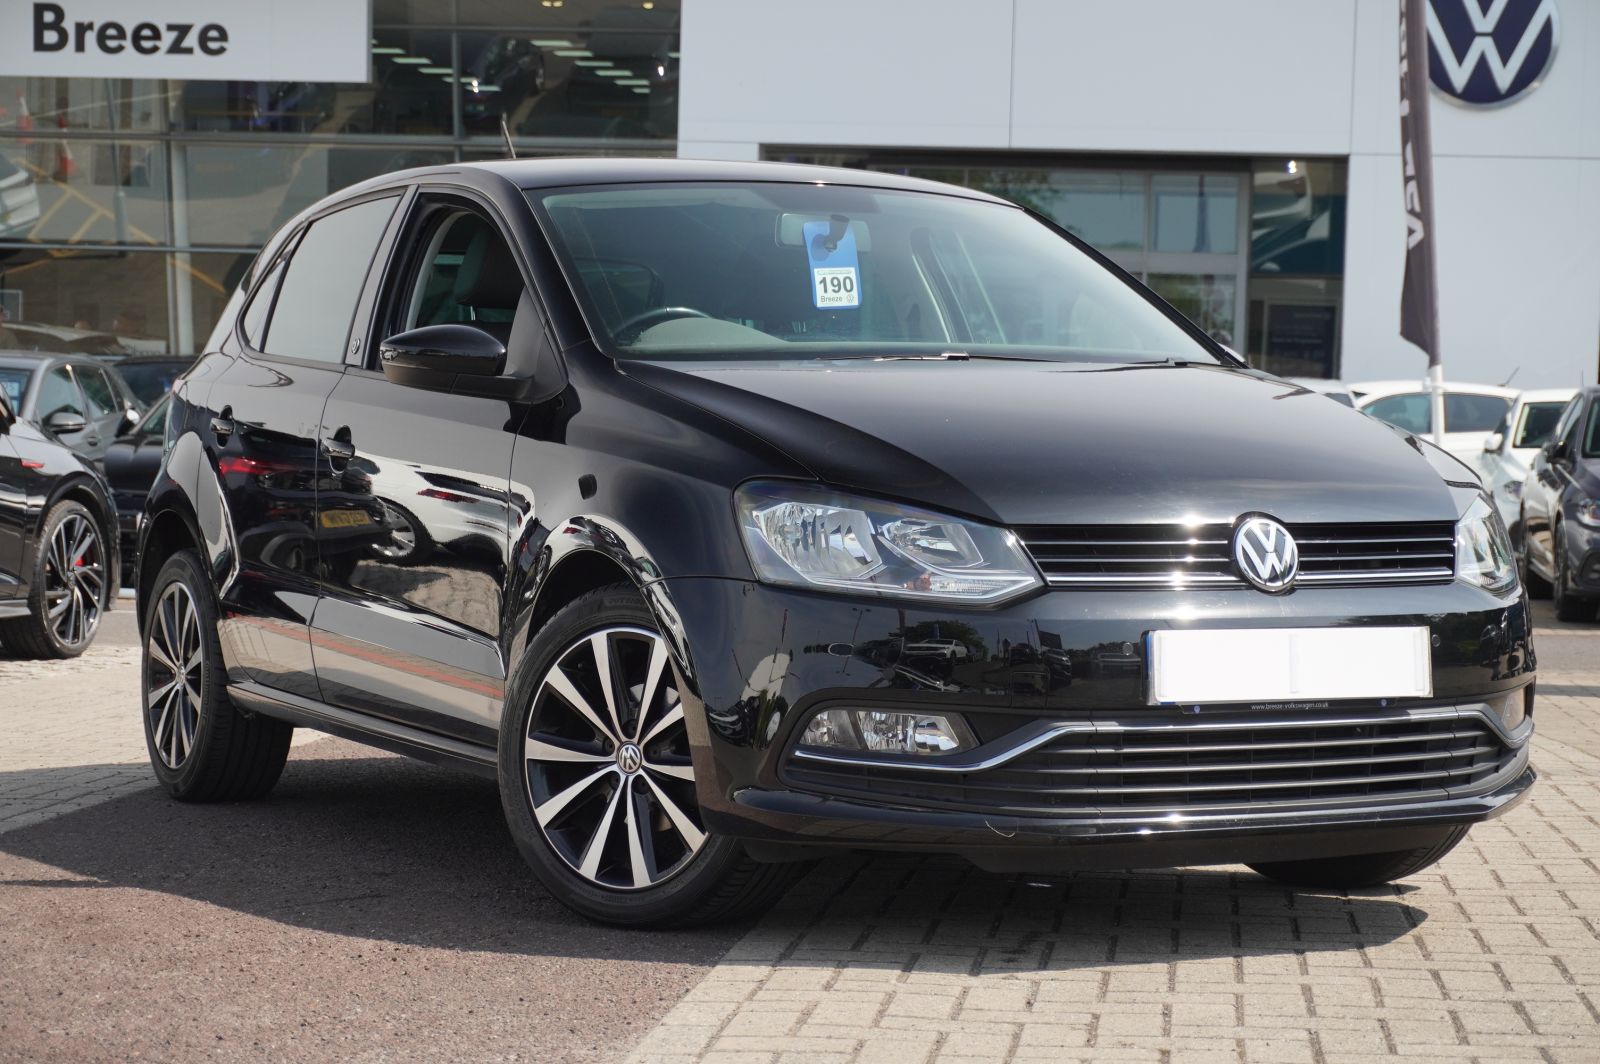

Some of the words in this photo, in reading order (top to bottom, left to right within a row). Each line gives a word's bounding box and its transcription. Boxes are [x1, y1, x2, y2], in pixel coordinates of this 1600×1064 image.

[33, 2, 229, 56] Breeze
[819, 276, 854, 294] 190
[1236, 518, 1298, 587] VW
